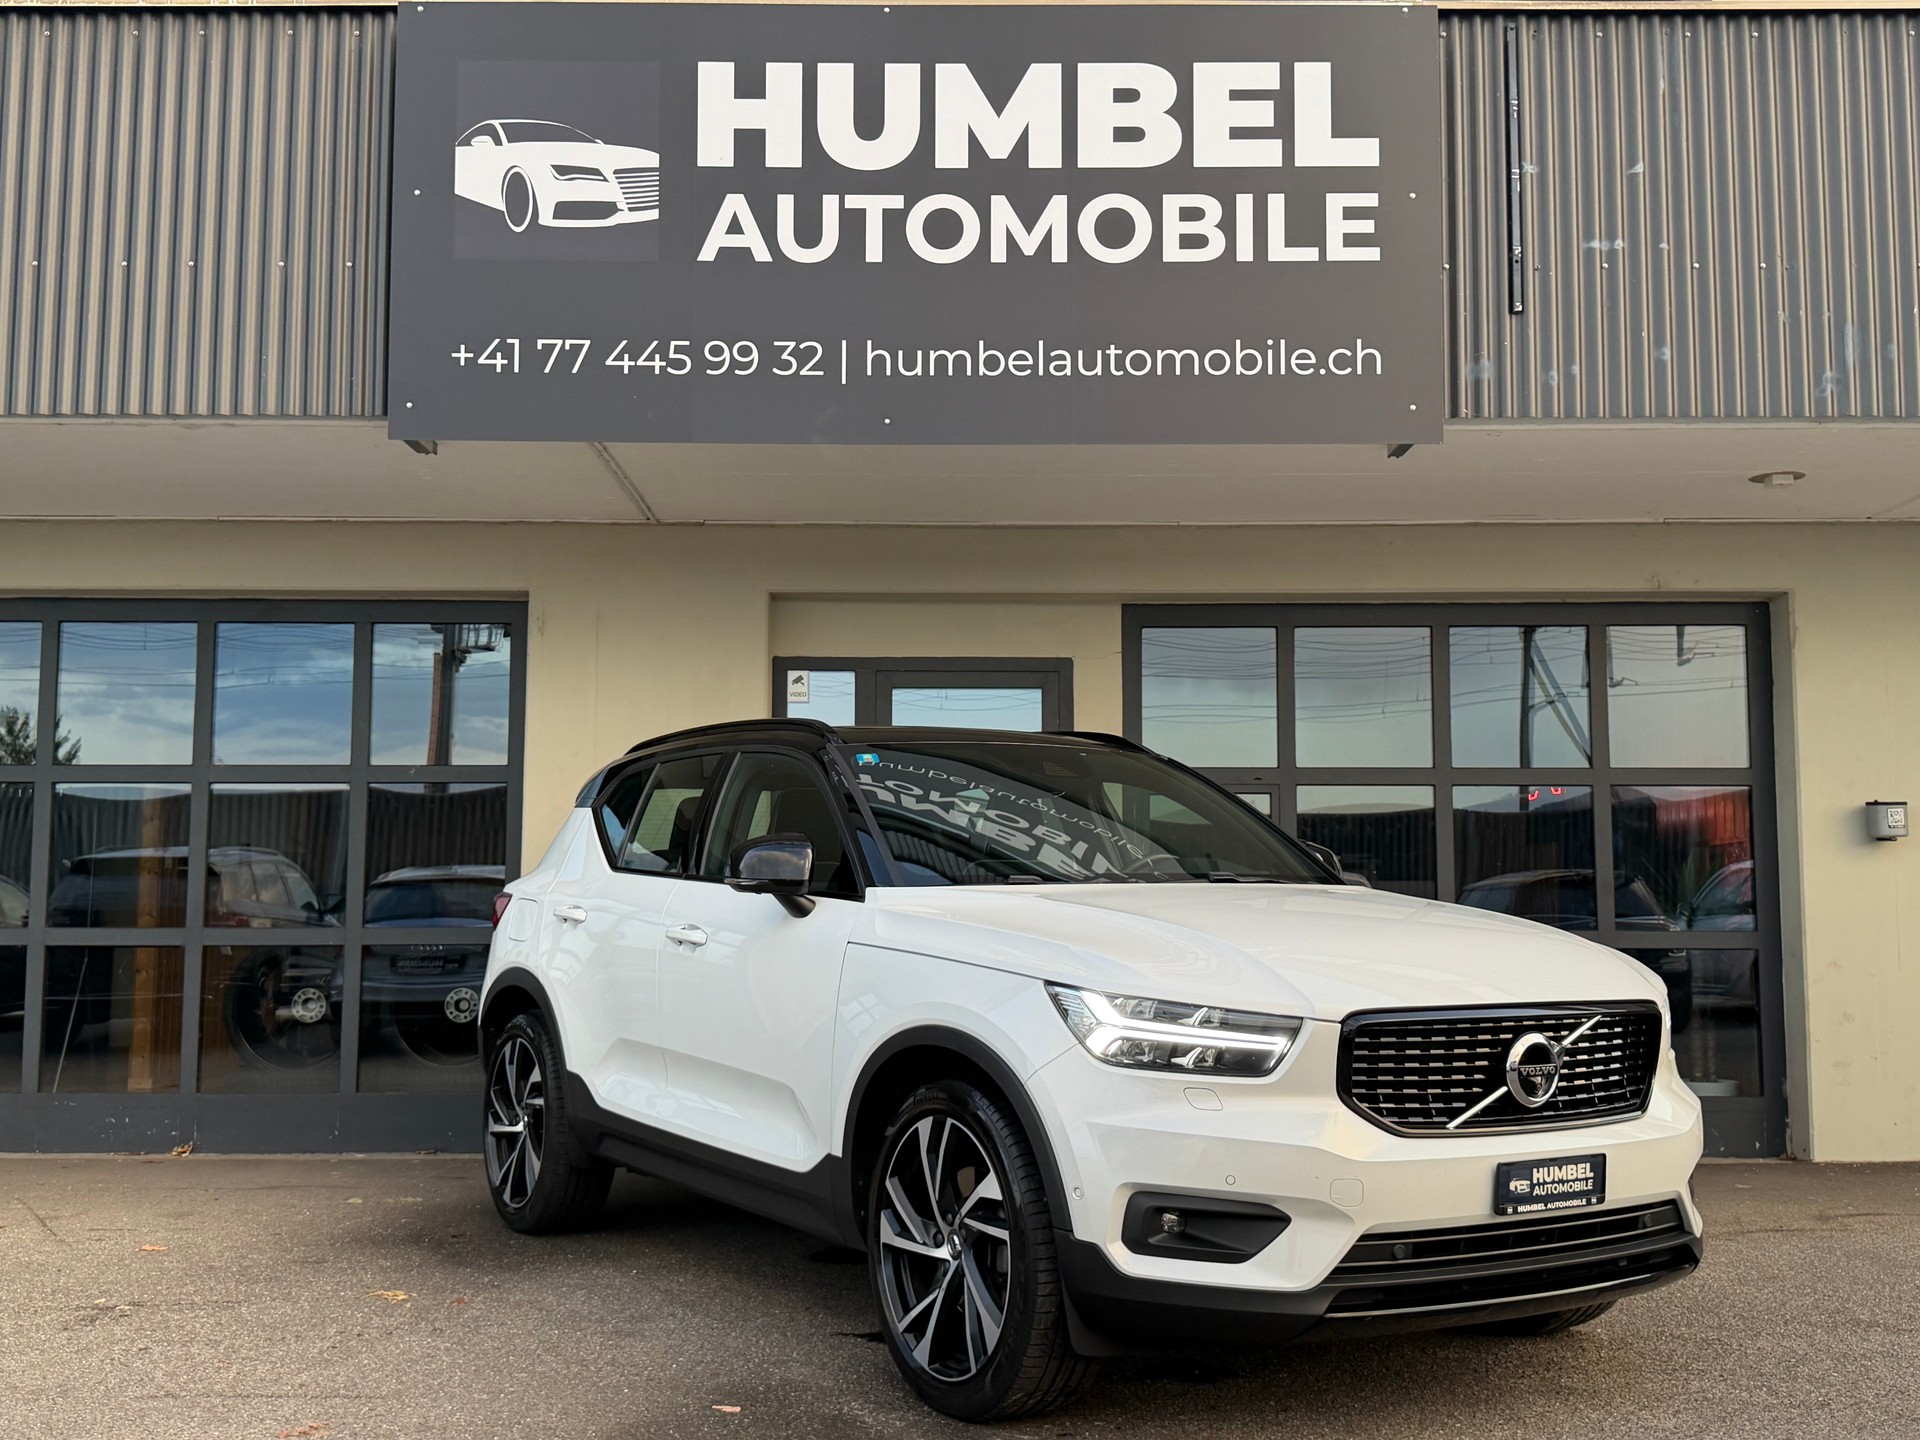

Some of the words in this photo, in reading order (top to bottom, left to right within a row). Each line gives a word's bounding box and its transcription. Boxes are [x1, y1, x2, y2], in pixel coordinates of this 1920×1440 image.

[696, 61, 1380, 171] HUMBEL
[696, 192, 1381, 264] AUTOMOBILE
[451, 338, 520, 374] +41
[536, 339, 591, 374] 77
[604, 340, 692, 375] 445
[703, 341, 759, 376] 99
[772, 341, 825, 376] 32
[866, 338, 1382, 377] humbelautomobile.ch
[1519, 1066, 1556, 1076] VOLVO
[1532, 1162, 1595, 1184] HUMBEL
[1532, 1179, 1594, 1197] AUTOMOBILE
[1517, 1203, 1546, 1213] HUMBEL
[1546, 1198, 1587, 1210] AUTOMOBILE
